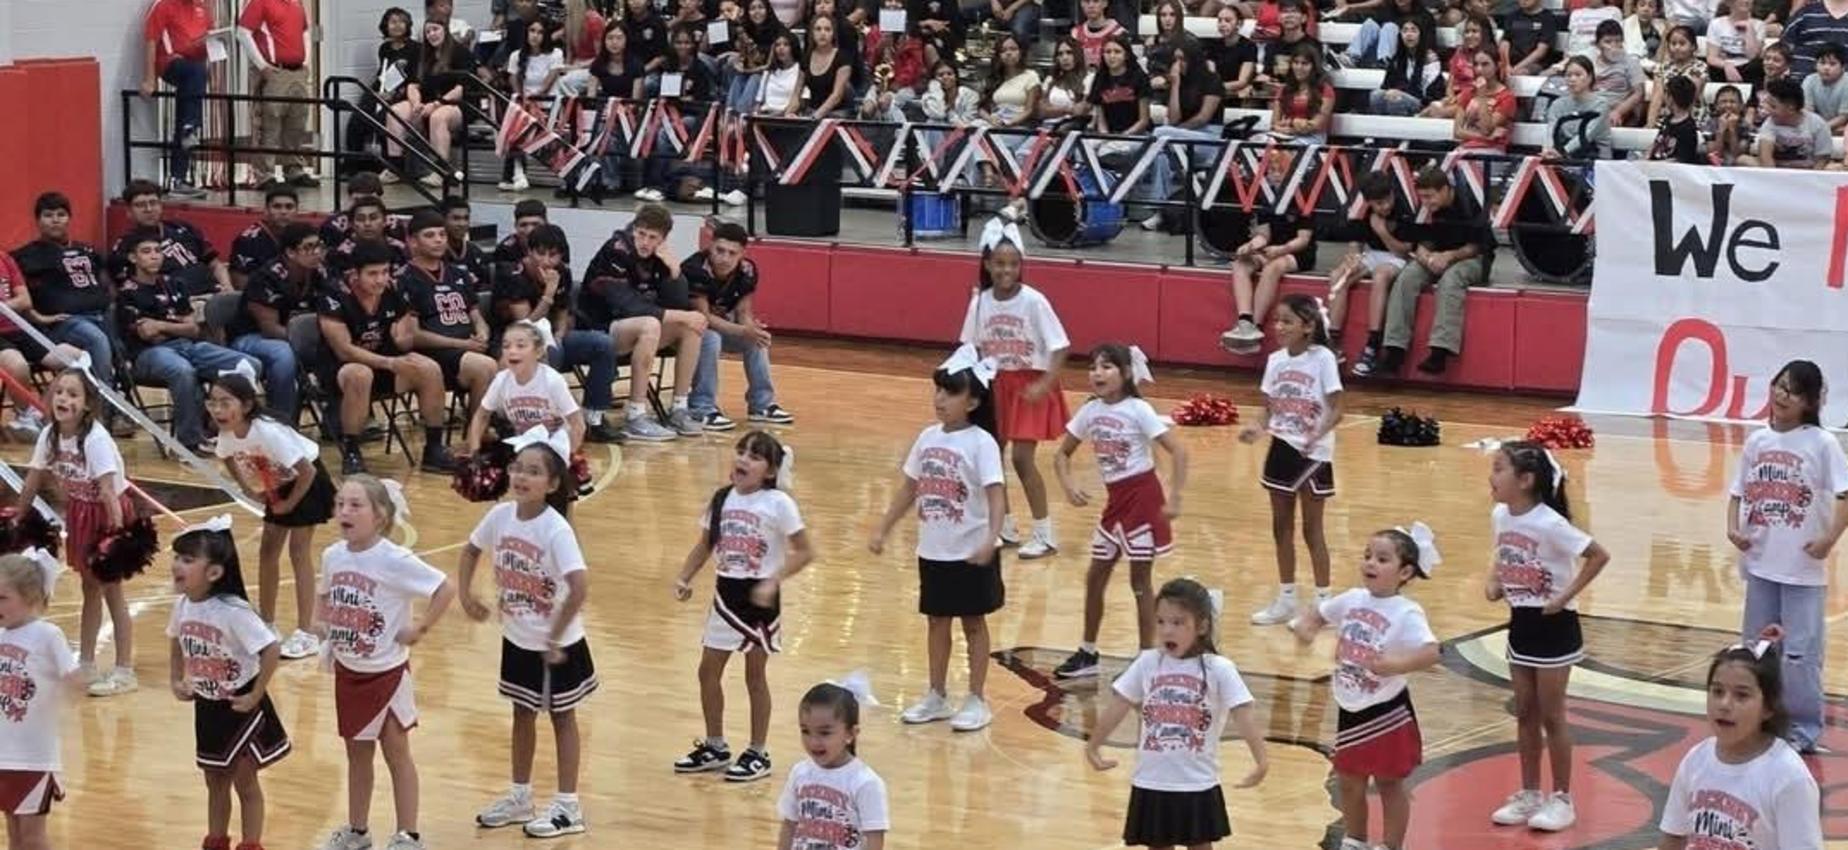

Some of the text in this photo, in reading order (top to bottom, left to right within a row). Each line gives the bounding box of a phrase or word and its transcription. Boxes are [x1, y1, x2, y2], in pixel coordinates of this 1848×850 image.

[1649, 180, 1780, 282] We
[1759, 464, 1788, 482] Mini
[329, 629, 359, 648] amp
[1695, 810, 1734, 841] Mini
